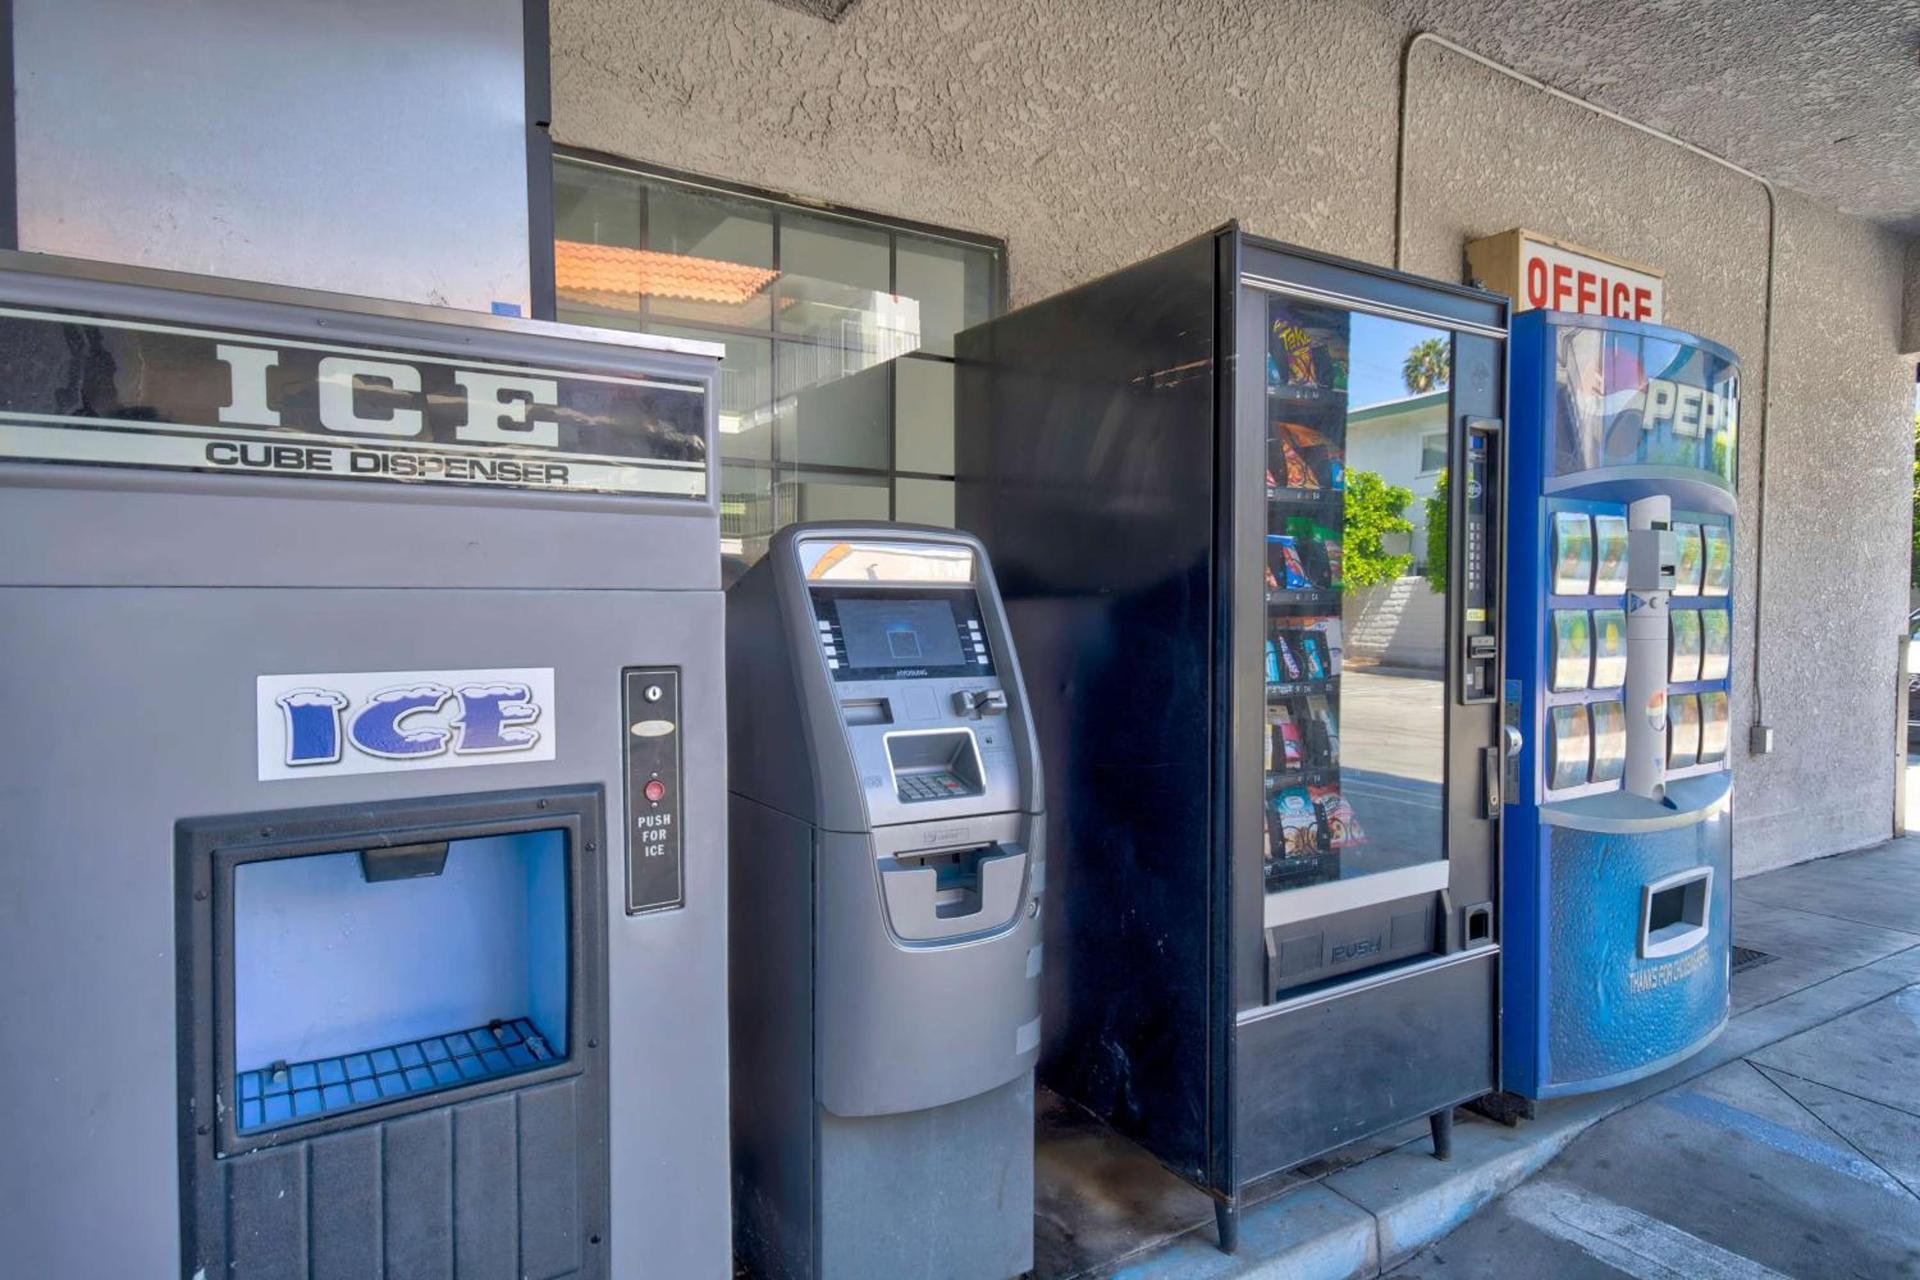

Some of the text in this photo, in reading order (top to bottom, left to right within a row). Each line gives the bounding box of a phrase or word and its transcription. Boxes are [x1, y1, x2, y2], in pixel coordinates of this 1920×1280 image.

[1527, 257, 1652, 321] OFFICE
[215, 344, 559, 447] ICE
[205, 441, 570, 486] CUBE DISPENSER
[275, 682, 541, 767] ICE
[638, 814, 671, 828] PUSH
[642, 829, 667, 842] FOR
[645, 845, 665, 857] ICE
[1331, 936, 1382, 963] PUSH
